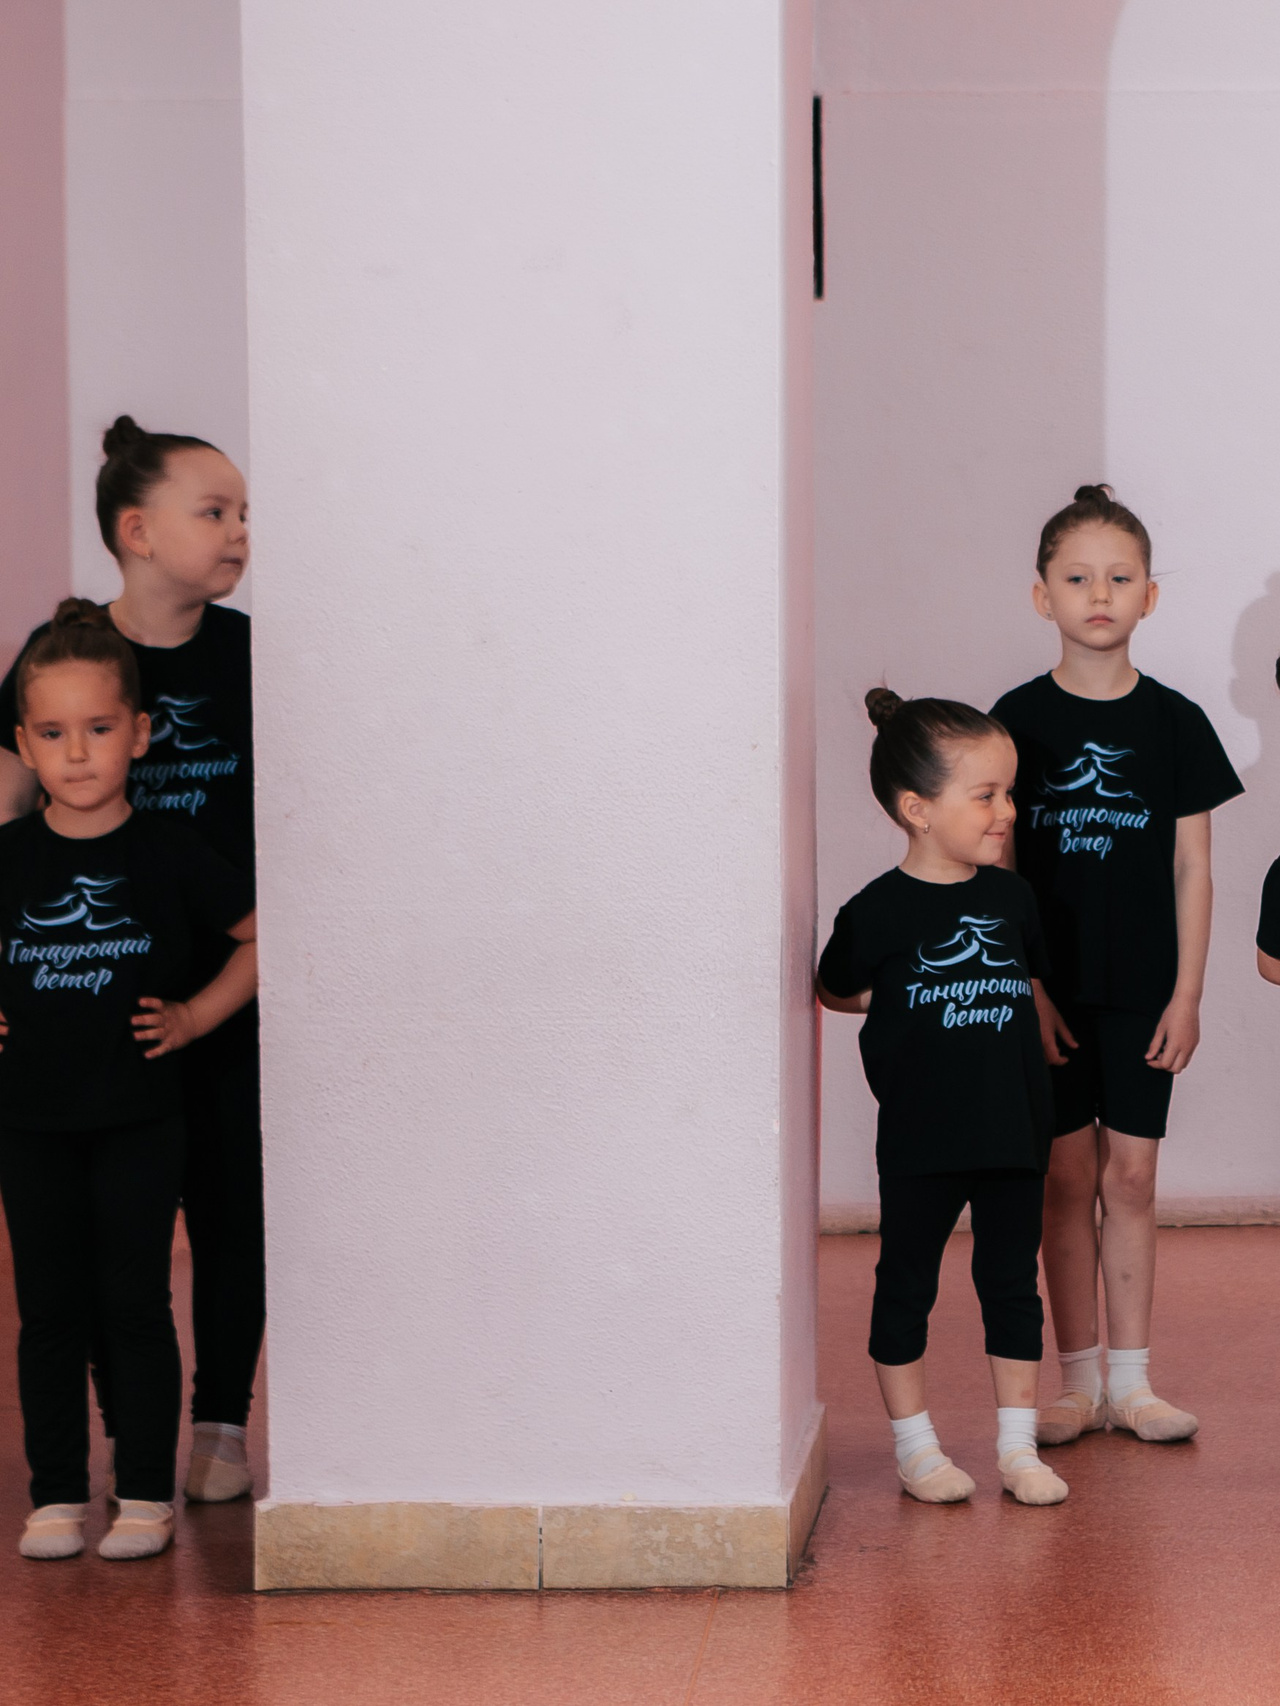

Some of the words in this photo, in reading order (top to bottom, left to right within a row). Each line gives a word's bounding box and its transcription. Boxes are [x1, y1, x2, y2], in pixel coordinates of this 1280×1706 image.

[129, 753, 240, 791] нцующий
[1030, 807, 1151, 832] Танцующий
[8, 933, 152, 969] Танцующий
[33, 963, 113, 995] ветер
[942, 1002, 1014, 1032] ветер
